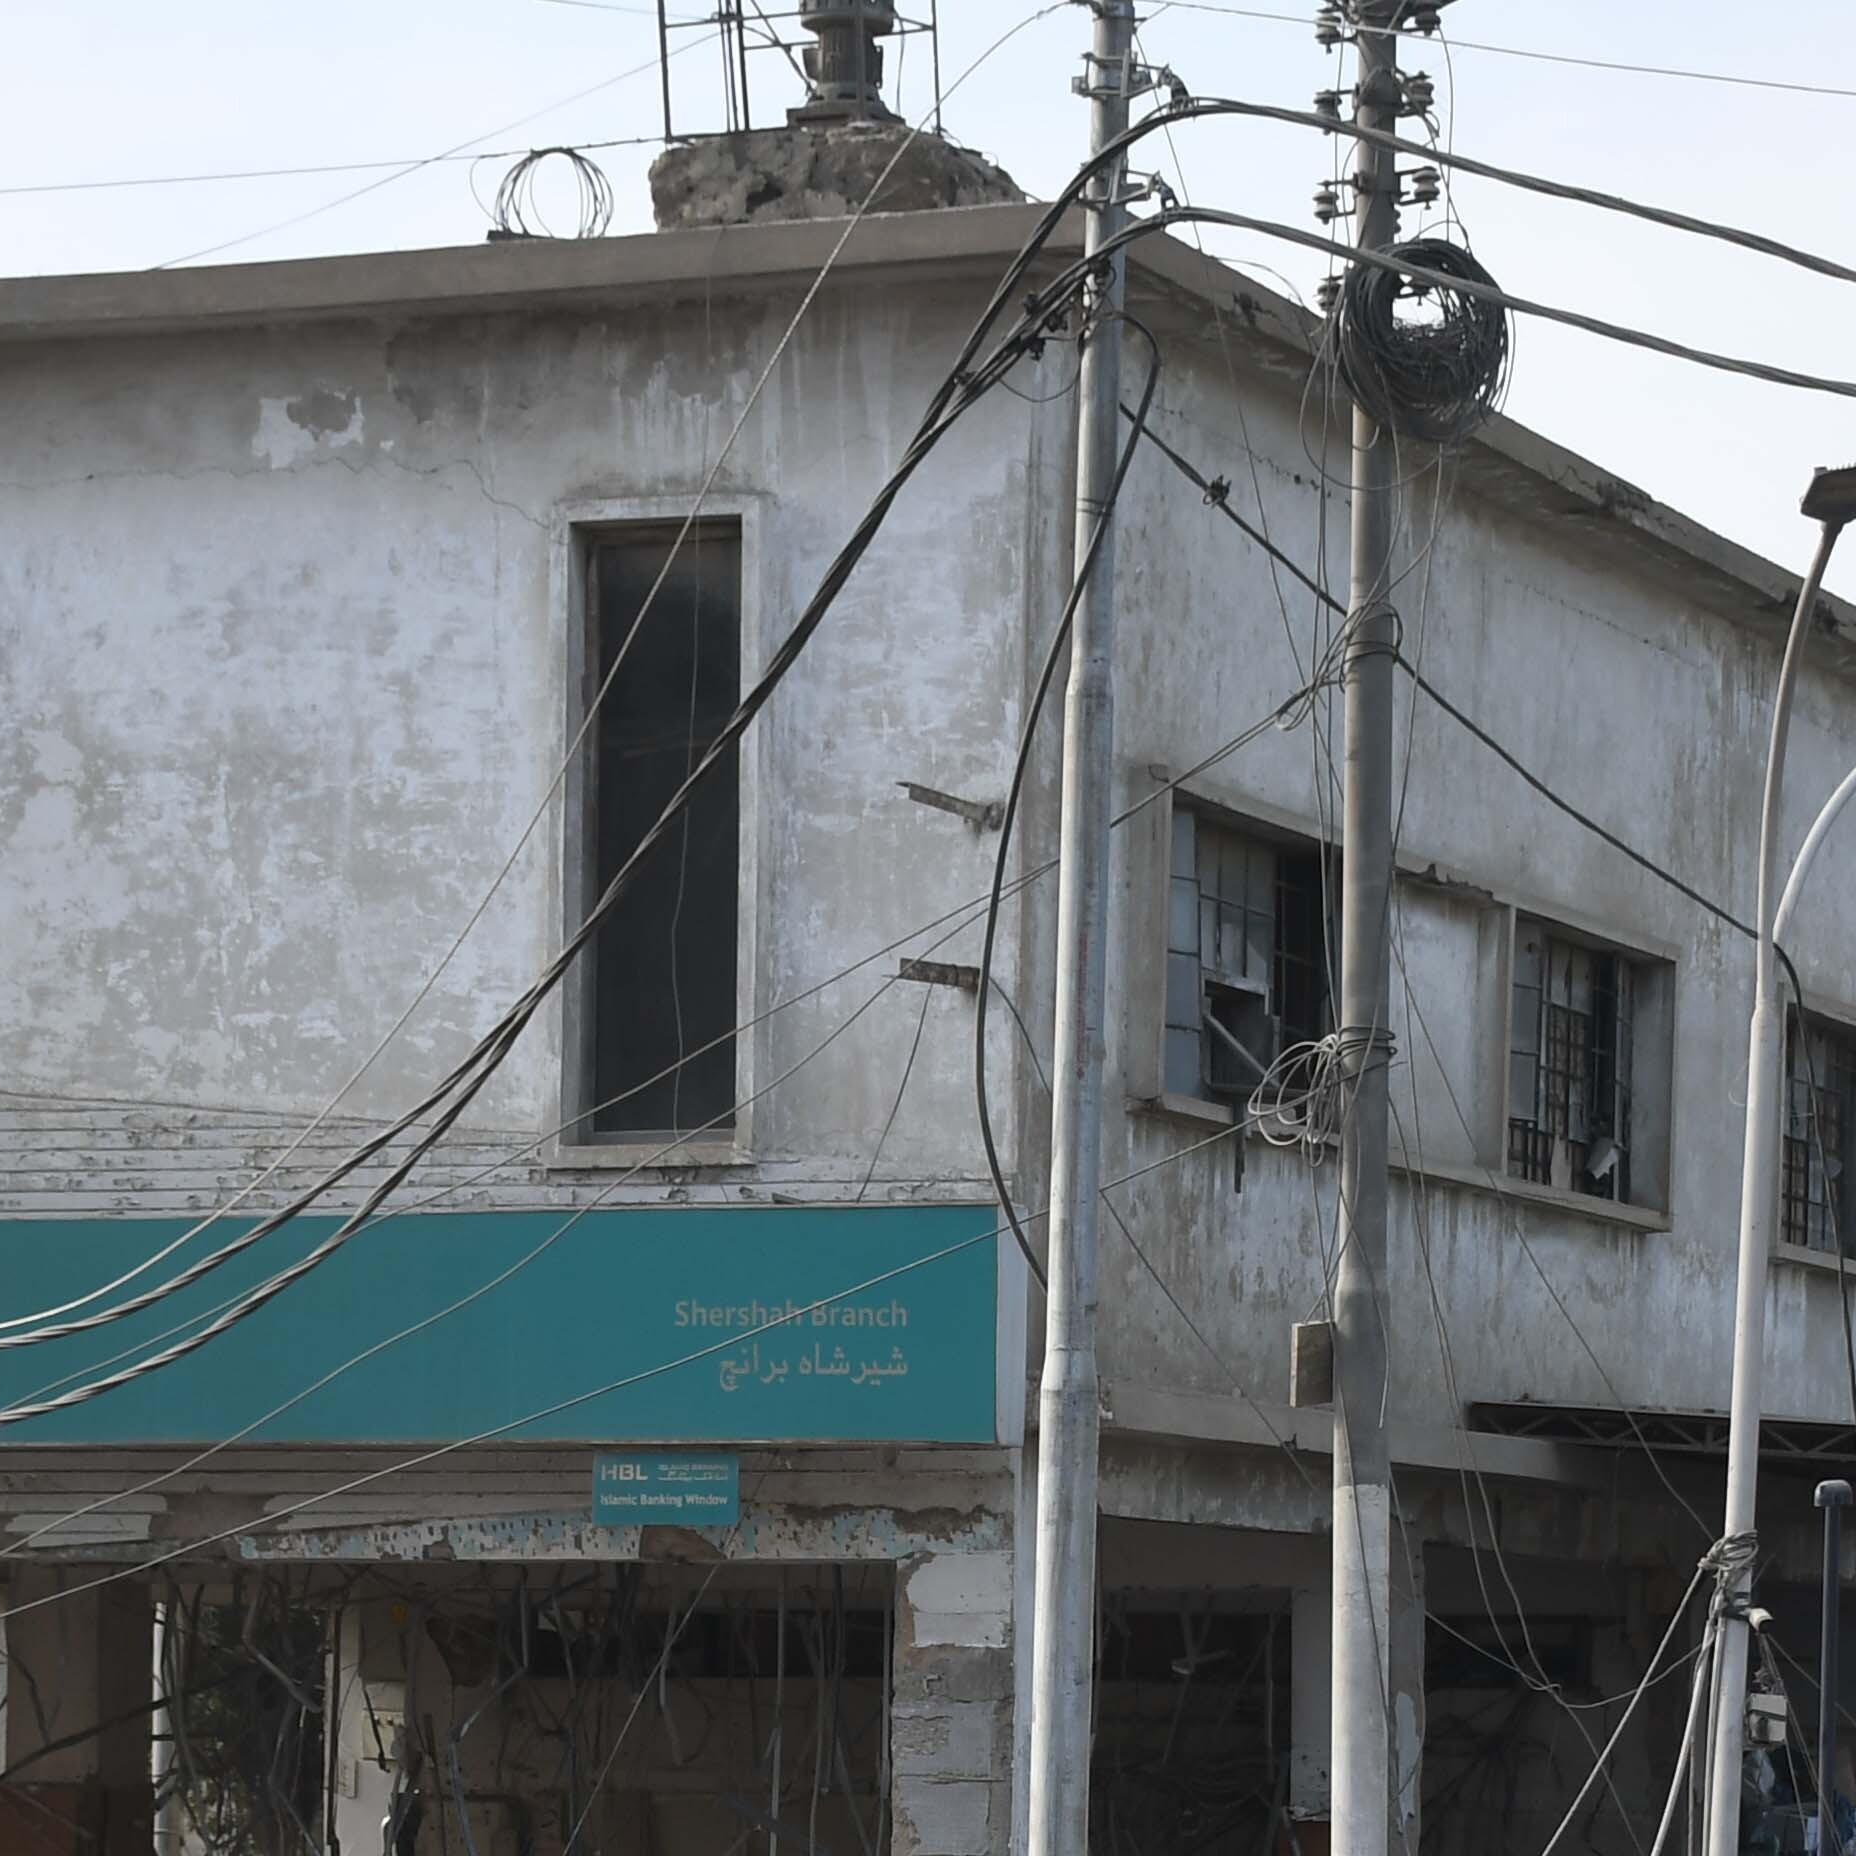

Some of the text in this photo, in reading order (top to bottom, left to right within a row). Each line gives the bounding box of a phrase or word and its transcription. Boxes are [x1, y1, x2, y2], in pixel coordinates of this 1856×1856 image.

[674, 1299, 908, 1328] Shershah Branch
[601, 1464, 648, 1480] HBL
[600, 1493, 728, 1507] Islamic Banking Window
